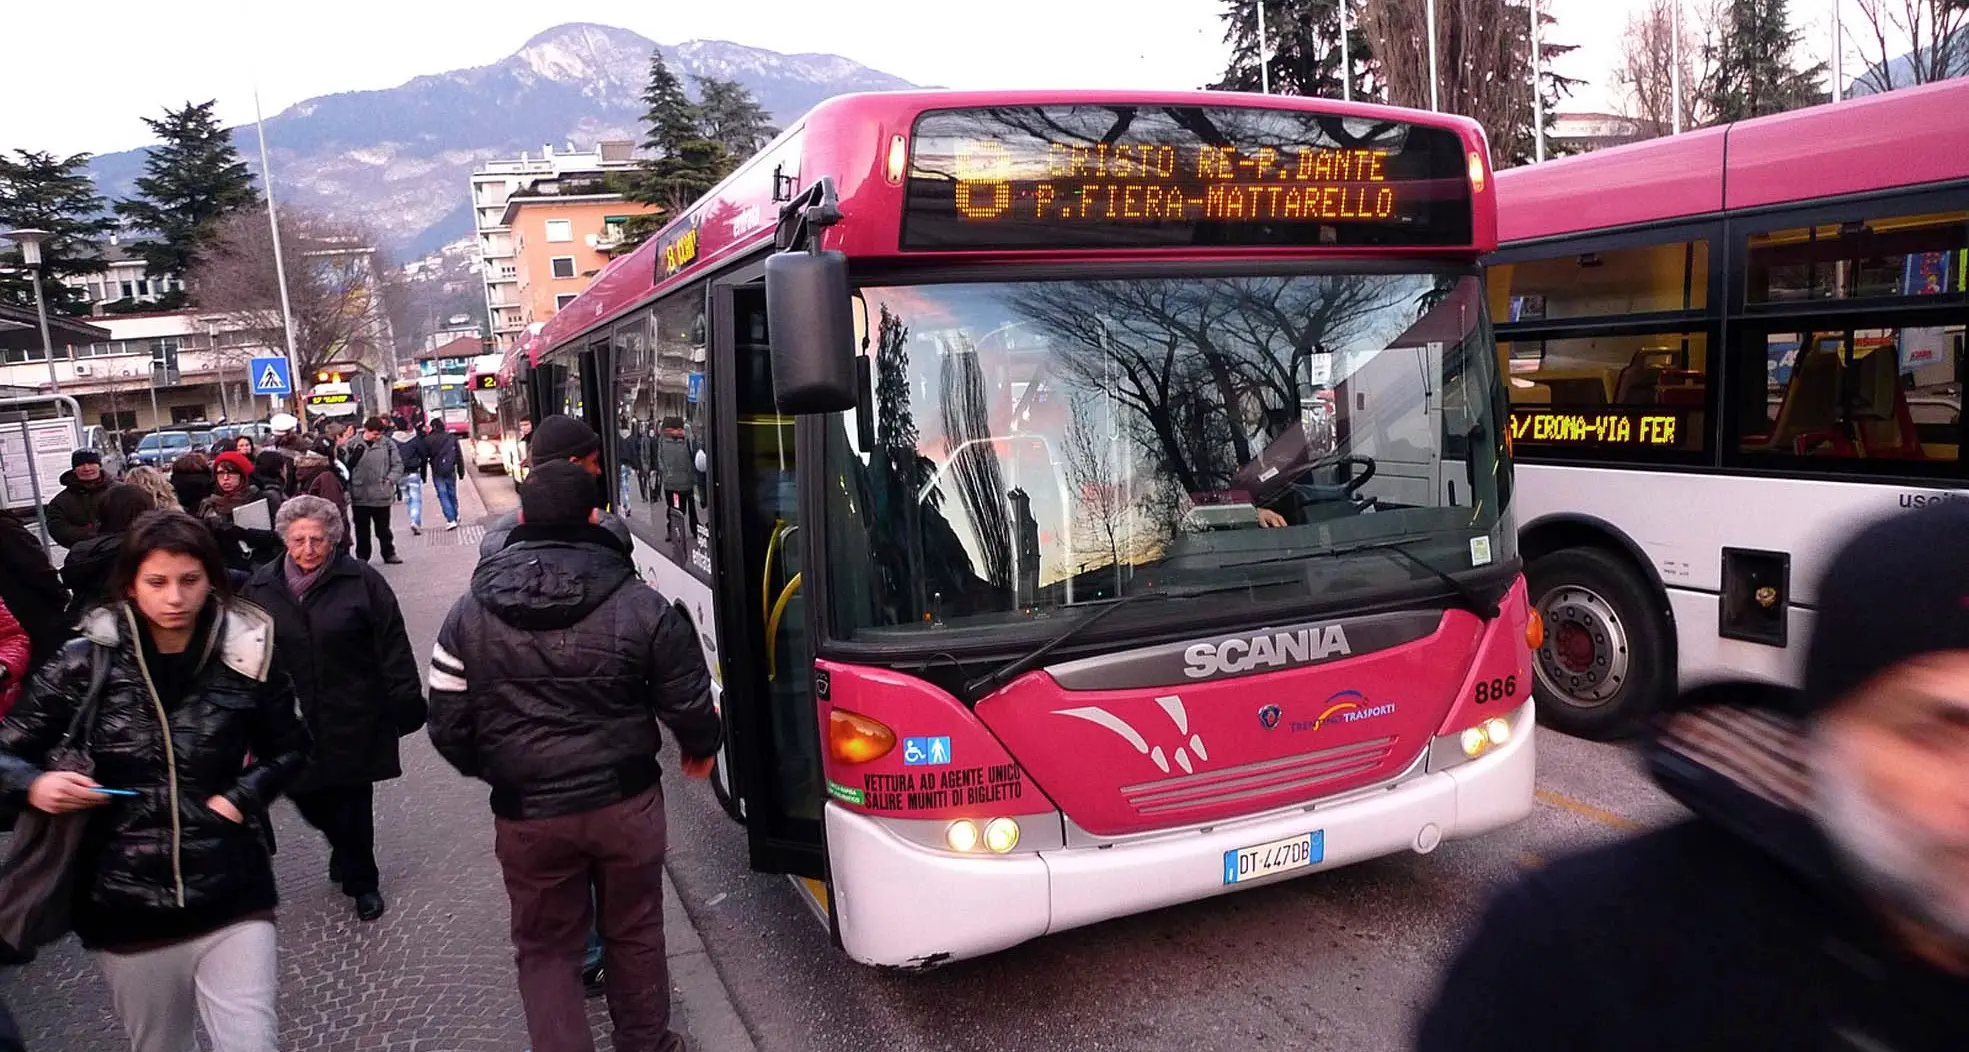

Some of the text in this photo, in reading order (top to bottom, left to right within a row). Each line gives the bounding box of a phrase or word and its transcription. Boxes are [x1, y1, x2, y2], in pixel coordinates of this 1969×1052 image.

[1049, 142, 1388, 181] CRISTO RE-P.DANTE
[955, 140, 1010, 218] 8
[1037, 183, 1393, 218] P.FIERA-MATTARELLO
[1639, 416, 1676, 443] FER
[1183, 624, 1352, 679] SCANIA
[1474, 675, 1516, 704] 886
[1343, 703, 1396, 723] TRASPORTI
[863, 773, 914, 792] VETTURA
[919, 772, 935, 791] AD
[940, 767, 984, 789] AGENTE
[988, 762, 1022, 782] UNICO
[863, 793, 904, 811] SALIRE
[907, 790, 948, 811] MUNITI
[952, 790, 964, 807] DI
[967, 781, 1023, 806] BIGLIETTO
[1239, 840, 1310, 875] DT 447DB
